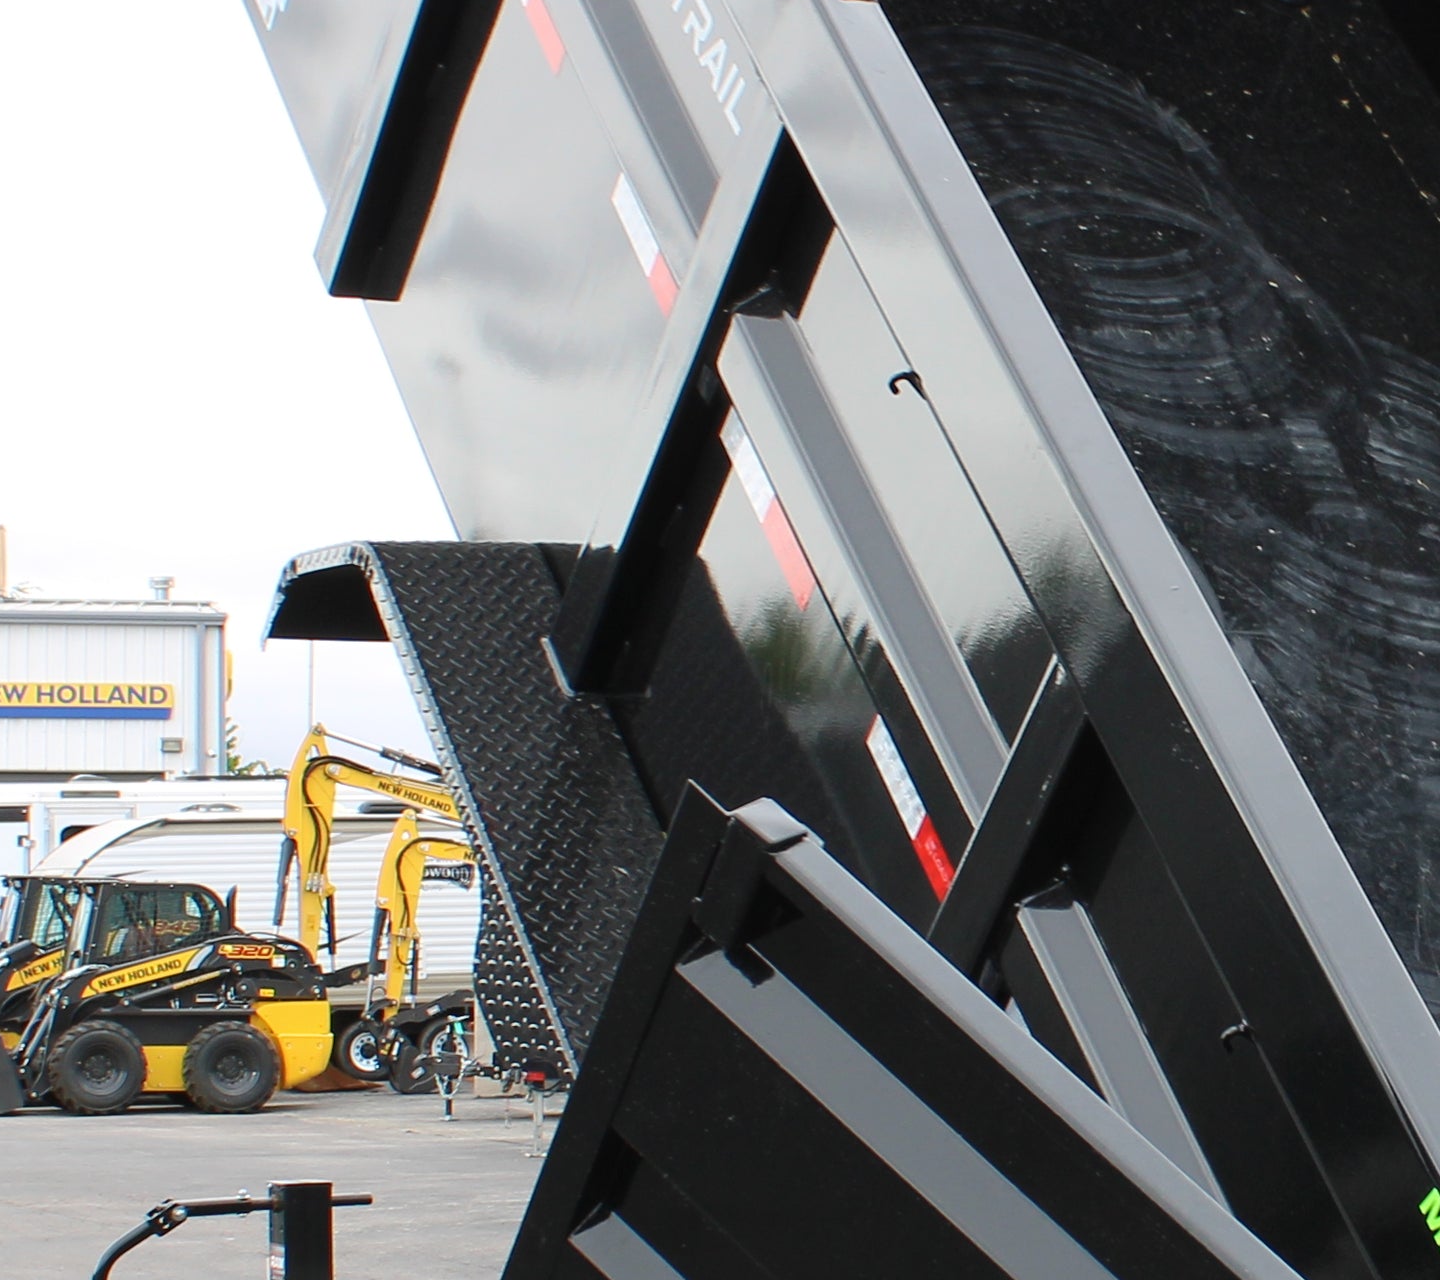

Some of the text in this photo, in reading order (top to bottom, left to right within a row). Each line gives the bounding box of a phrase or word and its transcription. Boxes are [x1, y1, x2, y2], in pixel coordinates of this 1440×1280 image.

[36, 684, 168, 705] HOLLAND
[377, 780, 452, 813] NEW HOLLAND
[23, 961, 51, 979] NEW
[98, 974, 126, 989] NEW
[127, 959, 182, 981] HOLLAND
